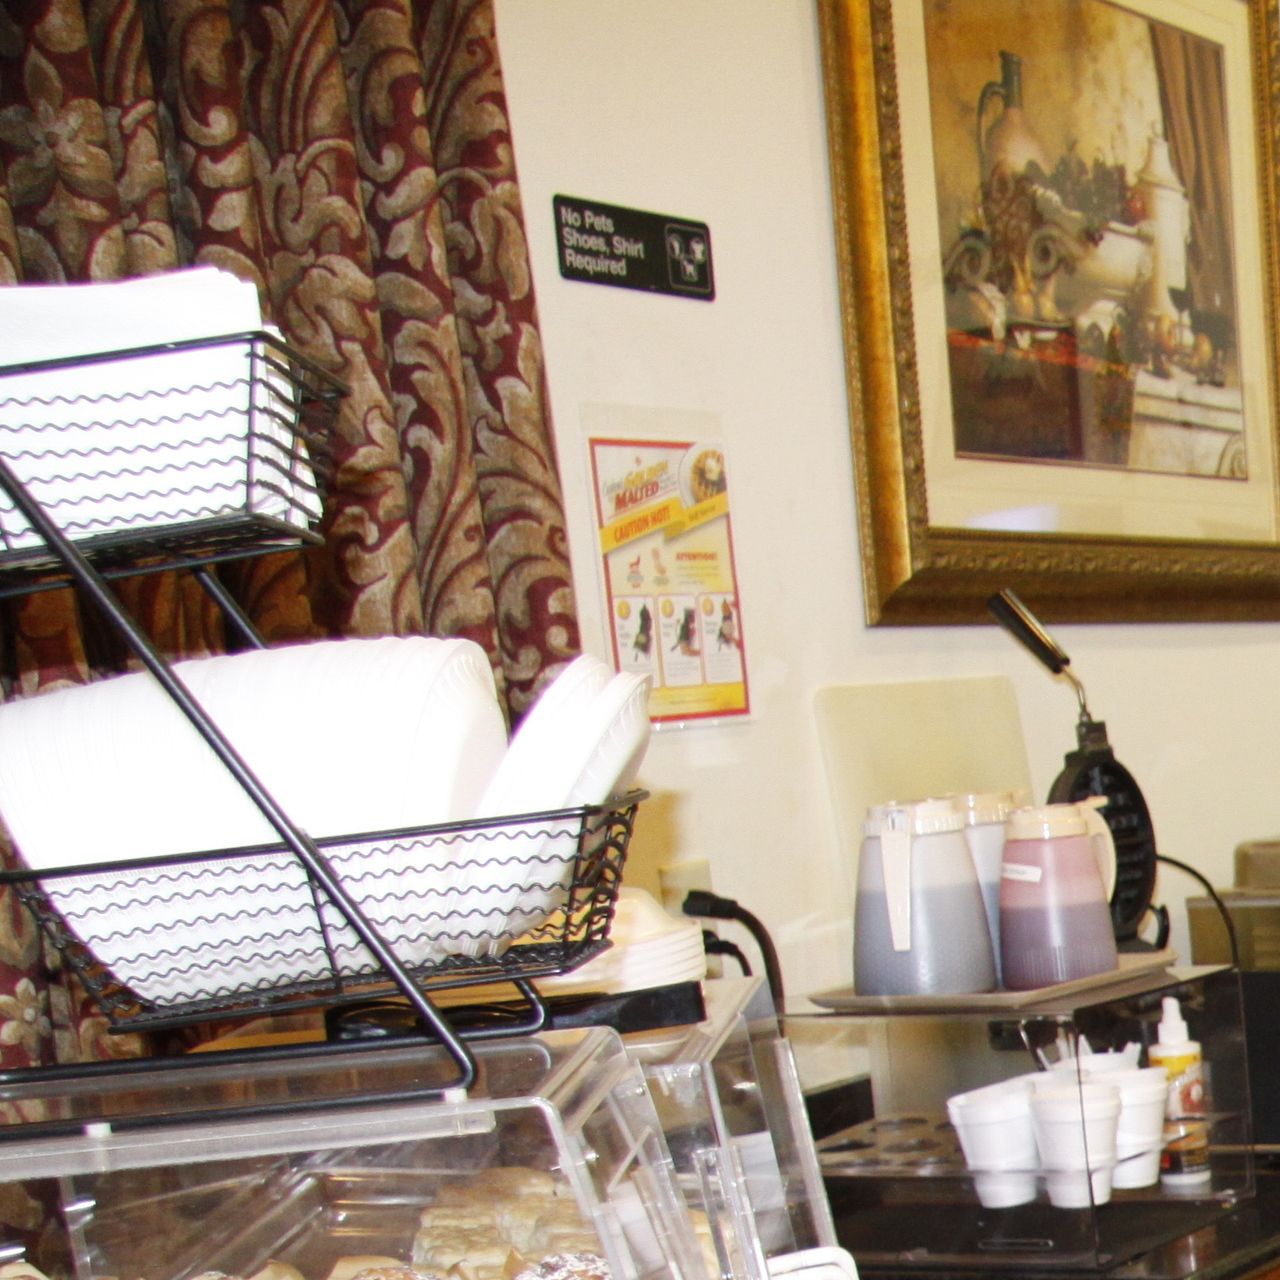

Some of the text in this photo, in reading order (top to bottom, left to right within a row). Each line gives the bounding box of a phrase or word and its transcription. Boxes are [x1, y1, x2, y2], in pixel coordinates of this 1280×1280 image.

[560, 206, 614, 233] No Pets
[563, 227, 645, 259] Shoes, Shirt
[564, 248, 627, 277] Required
[615, 481, 660, 511] MALTED
[614, 515, 650, 543] CAUTION
